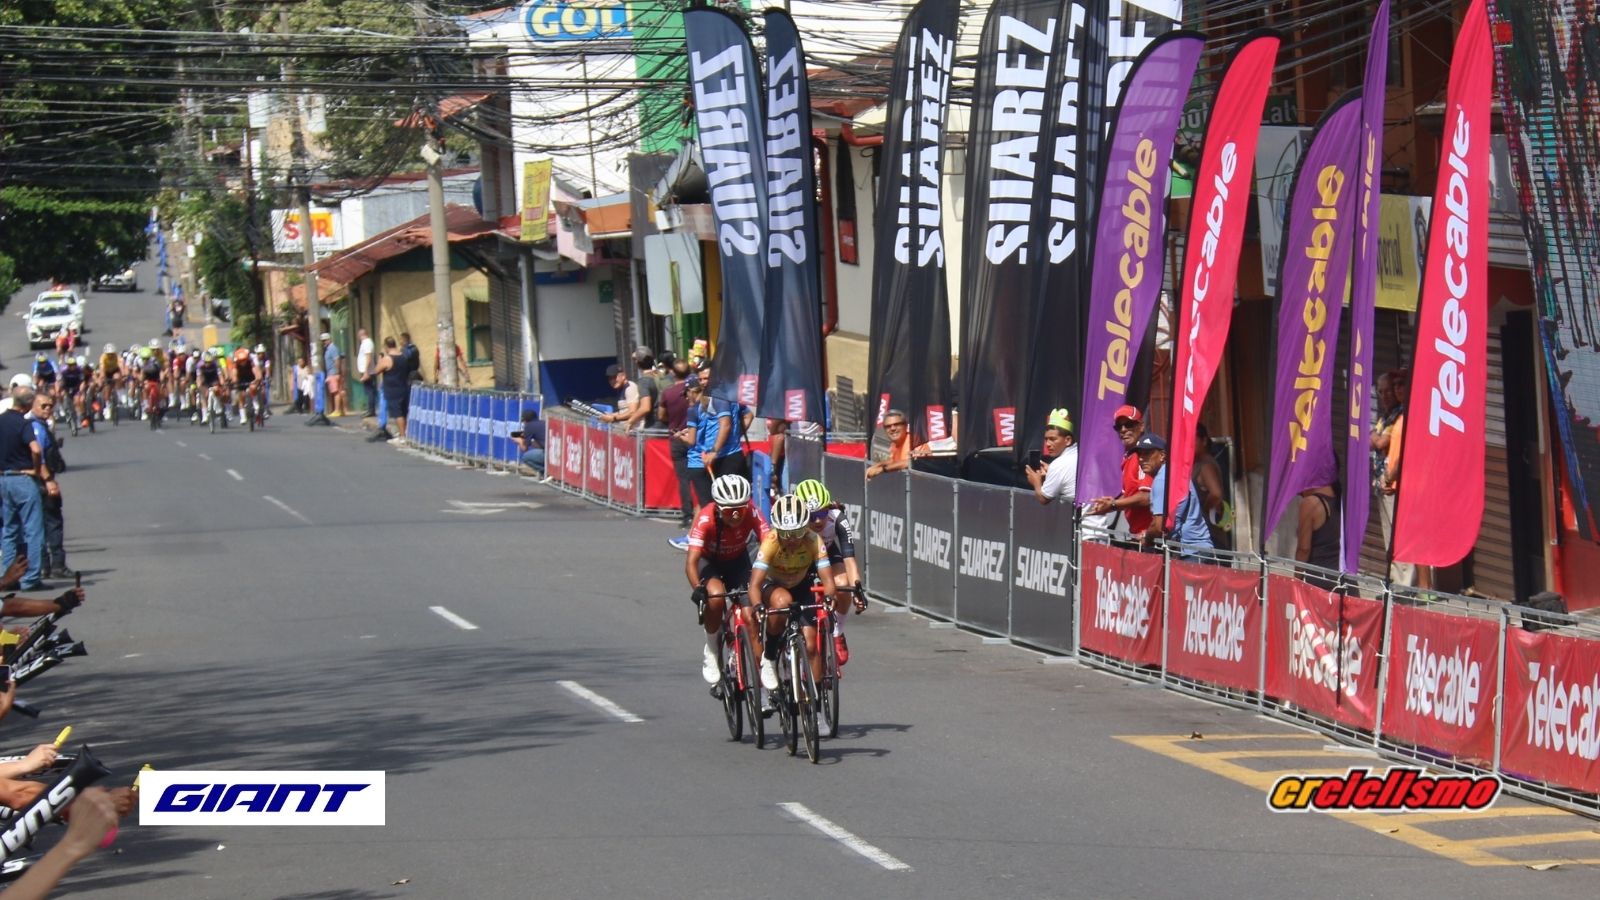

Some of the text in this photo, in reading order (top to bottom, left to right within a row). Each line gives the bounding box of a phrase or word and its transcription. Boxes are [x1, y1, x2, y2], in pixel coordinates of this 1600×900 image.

[985, 15, 1056, 265] SUAREZ
[283, 219, 330, 240] SR
[1098, 138, 1157, 401] Telecable
[1429, 110, 1470, 437] Telecable
[783, 516, 795, 525] 61
[870, 510, 904, 553] SUAREZ
[914, 522, 951, 569] SUAREZ
[960, 536, 1006, 582] SUAREZ
[1016, 546, 1068, 596] SUAREZ
[1095, 566, 1150, 639] Telecable
[1183, 585, 1246, 662] Telecable
[1405, 634, 1481, 728] Telecable
